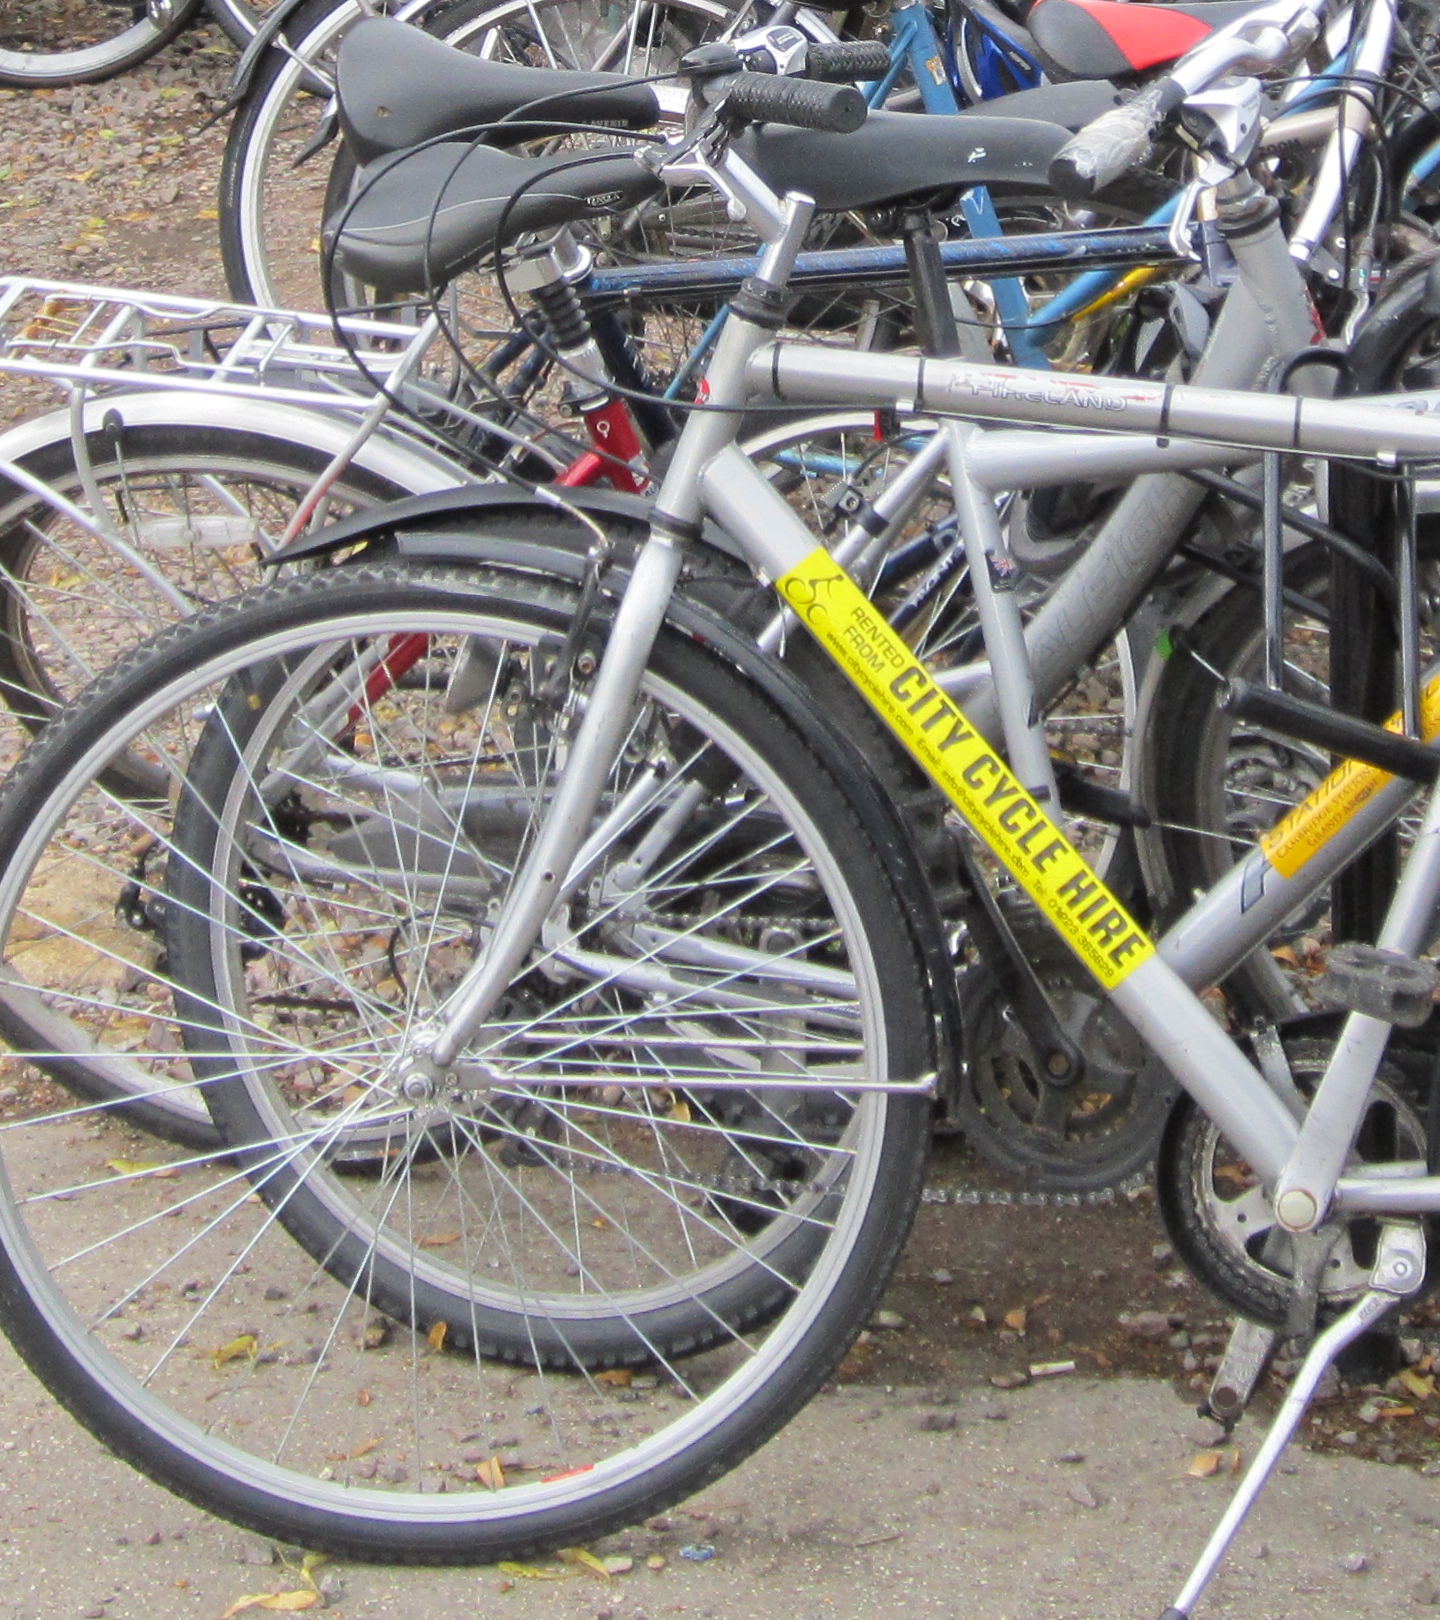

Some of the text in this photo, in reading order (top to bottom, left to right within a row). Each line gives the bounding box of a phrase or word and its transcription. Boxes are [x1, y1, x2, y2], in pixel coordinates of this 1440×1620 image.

[842, 625, 887, 674] FROM
[849, 607, 905, 670] RENTED
[825, 630, 915, 738] www.citycyclehire.com
[940, 766, 1031, 879] info@citycyclehire.com
[888, 664, 974, 754] CITY
[961, 750, 1065, 875] CYCLE
[1056, 872, 1151, 973] HIRE
